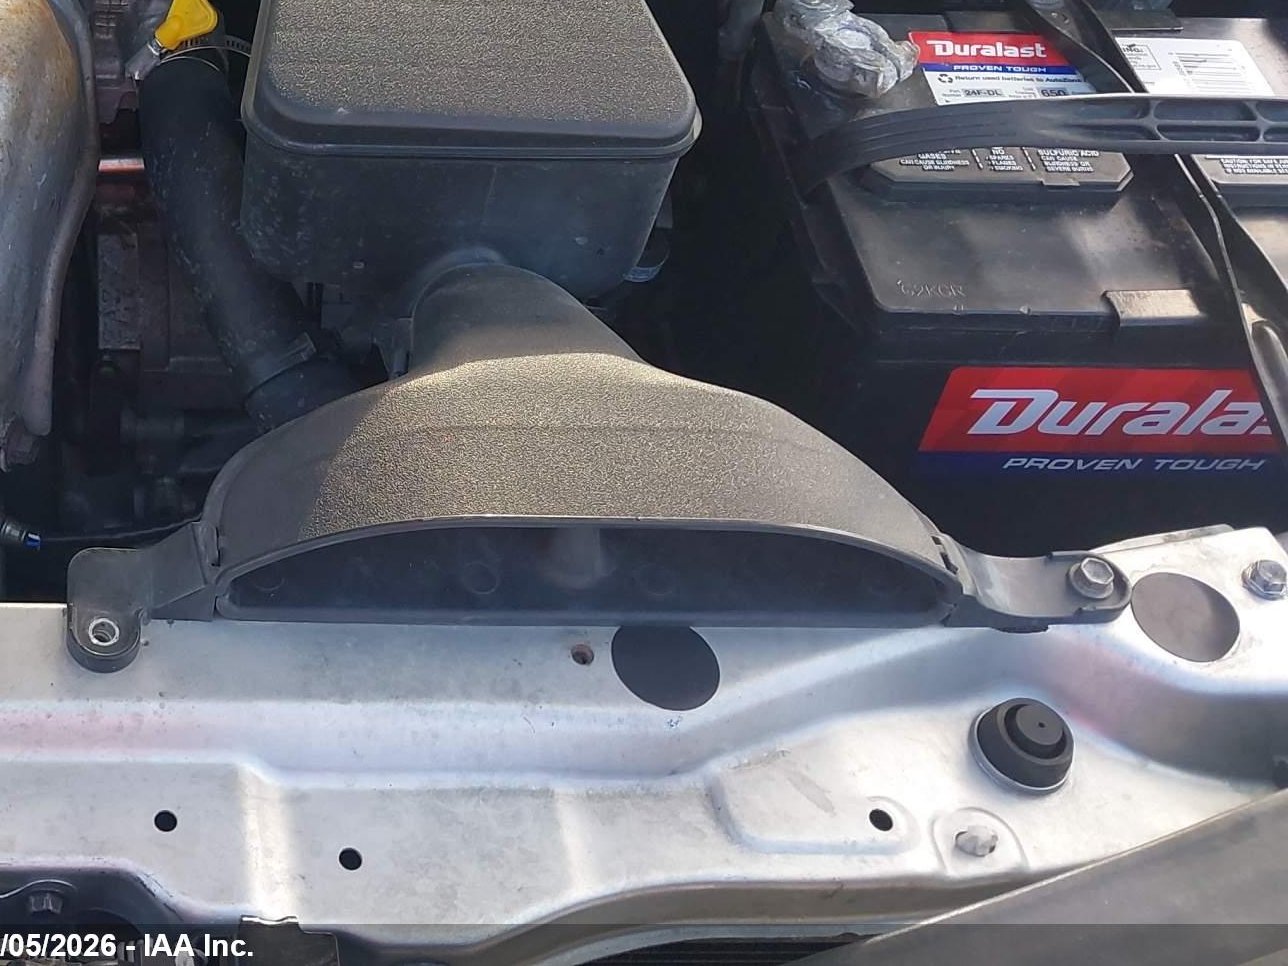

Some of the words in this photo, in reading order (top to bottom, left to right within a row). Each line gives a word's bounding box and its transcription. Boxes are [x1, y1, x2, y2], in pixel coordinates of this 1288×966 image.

[926, 39, 1048, 58] Duralast
[967, 389, 1273, 435] Durala
[1002, 458, 1142, 470] PROVEN
[1154, 458, 1265, 470] TOUGH
